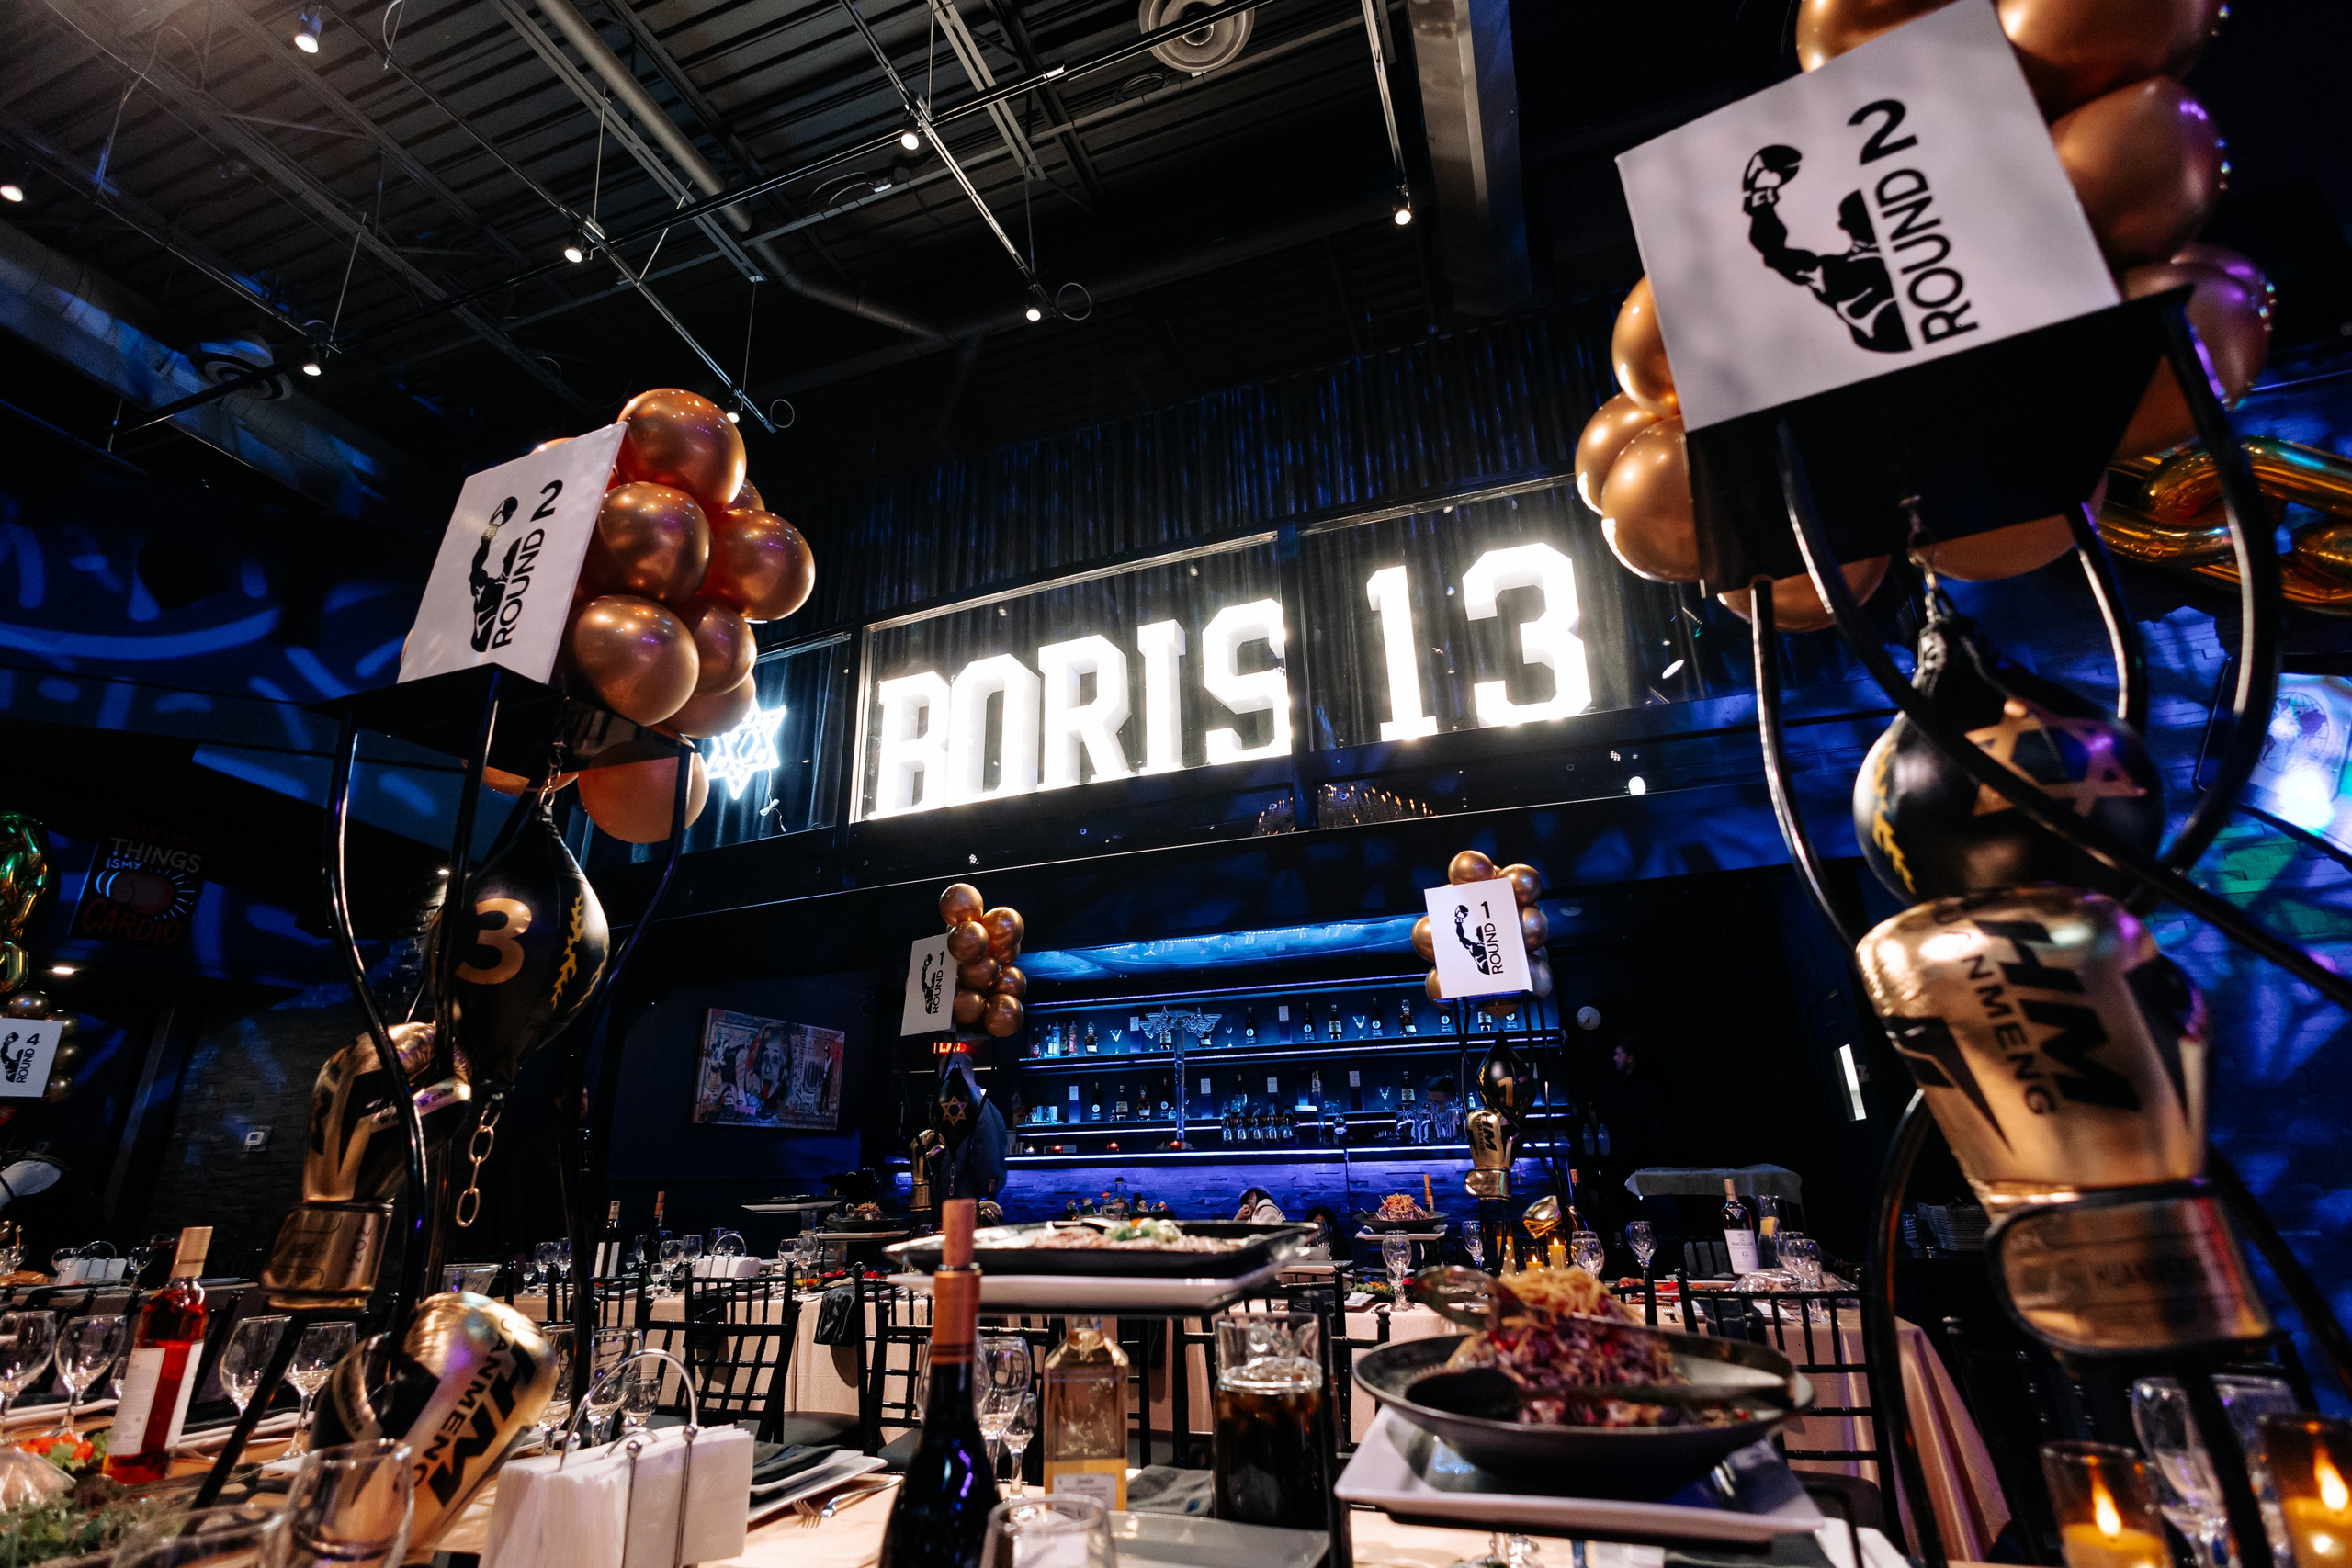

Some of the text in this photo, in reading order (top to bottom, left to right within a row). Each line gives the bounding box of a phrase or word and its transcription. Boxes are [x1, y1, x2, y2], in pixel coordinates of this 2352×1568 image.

[1847, 99, 1980, 345] ROUND 2
[490, 479, 563, 650] ROUND 2
[871, 542, 1592, 820] BORIS 13
[110, 837, 201, 874] THINGS
[81, 897, 182, 945] CARDIO
[455, 897, 533, 985] 3
[1480, 901, 1504, 975] ROUND 1
[932, 951, 944, 1014] ROUND 1
[16, 1033, 40, 1083] ROUND 4
[1498, 1077, 1514, 1107] 1
